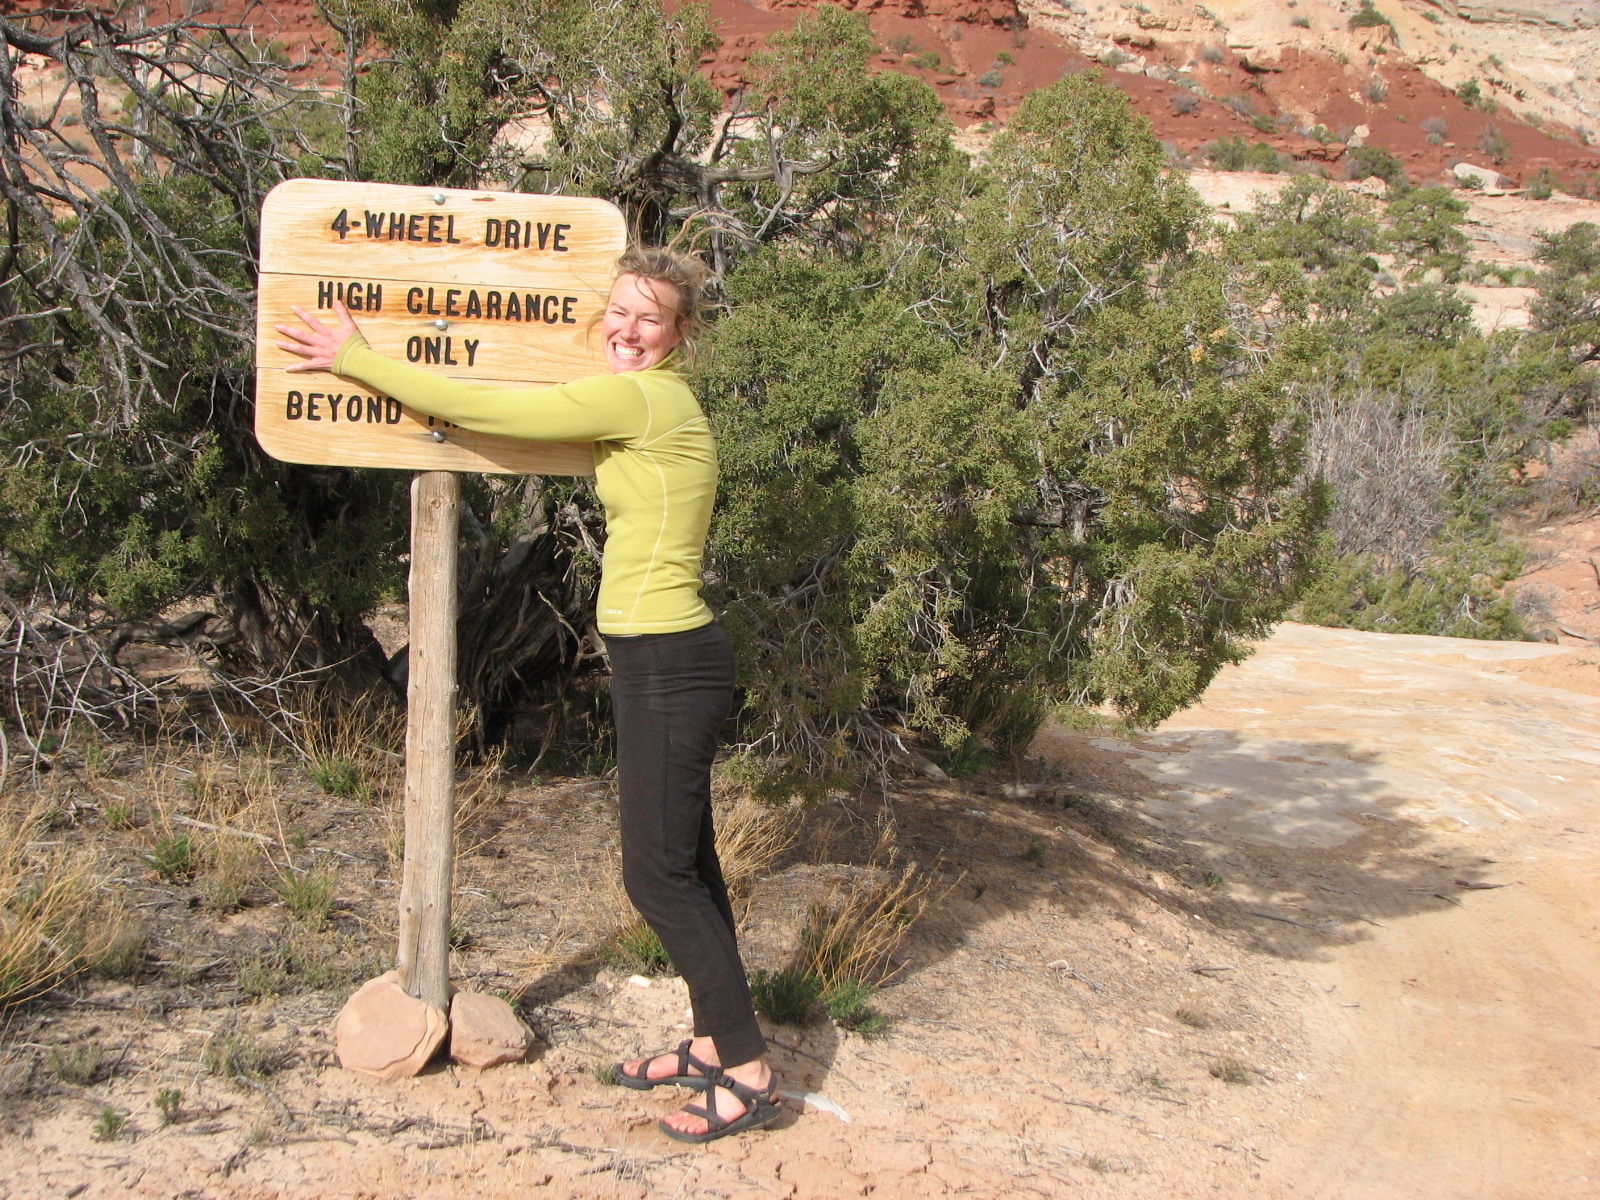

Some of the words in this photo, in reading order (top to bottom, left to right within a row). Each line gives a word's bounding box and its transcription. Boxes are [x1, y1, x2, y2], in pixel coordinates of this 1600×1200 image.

[331, 208, 460, 244] 4-WHEEL
[485, 218, 571, 252] DRIVE
[318, 280, 382, 312] HIGH
[407, 287, 578, 324] CLEARANCE
[406, 335, 480, 366] ONLY
[286, 390, 402, 425] BEYOND
